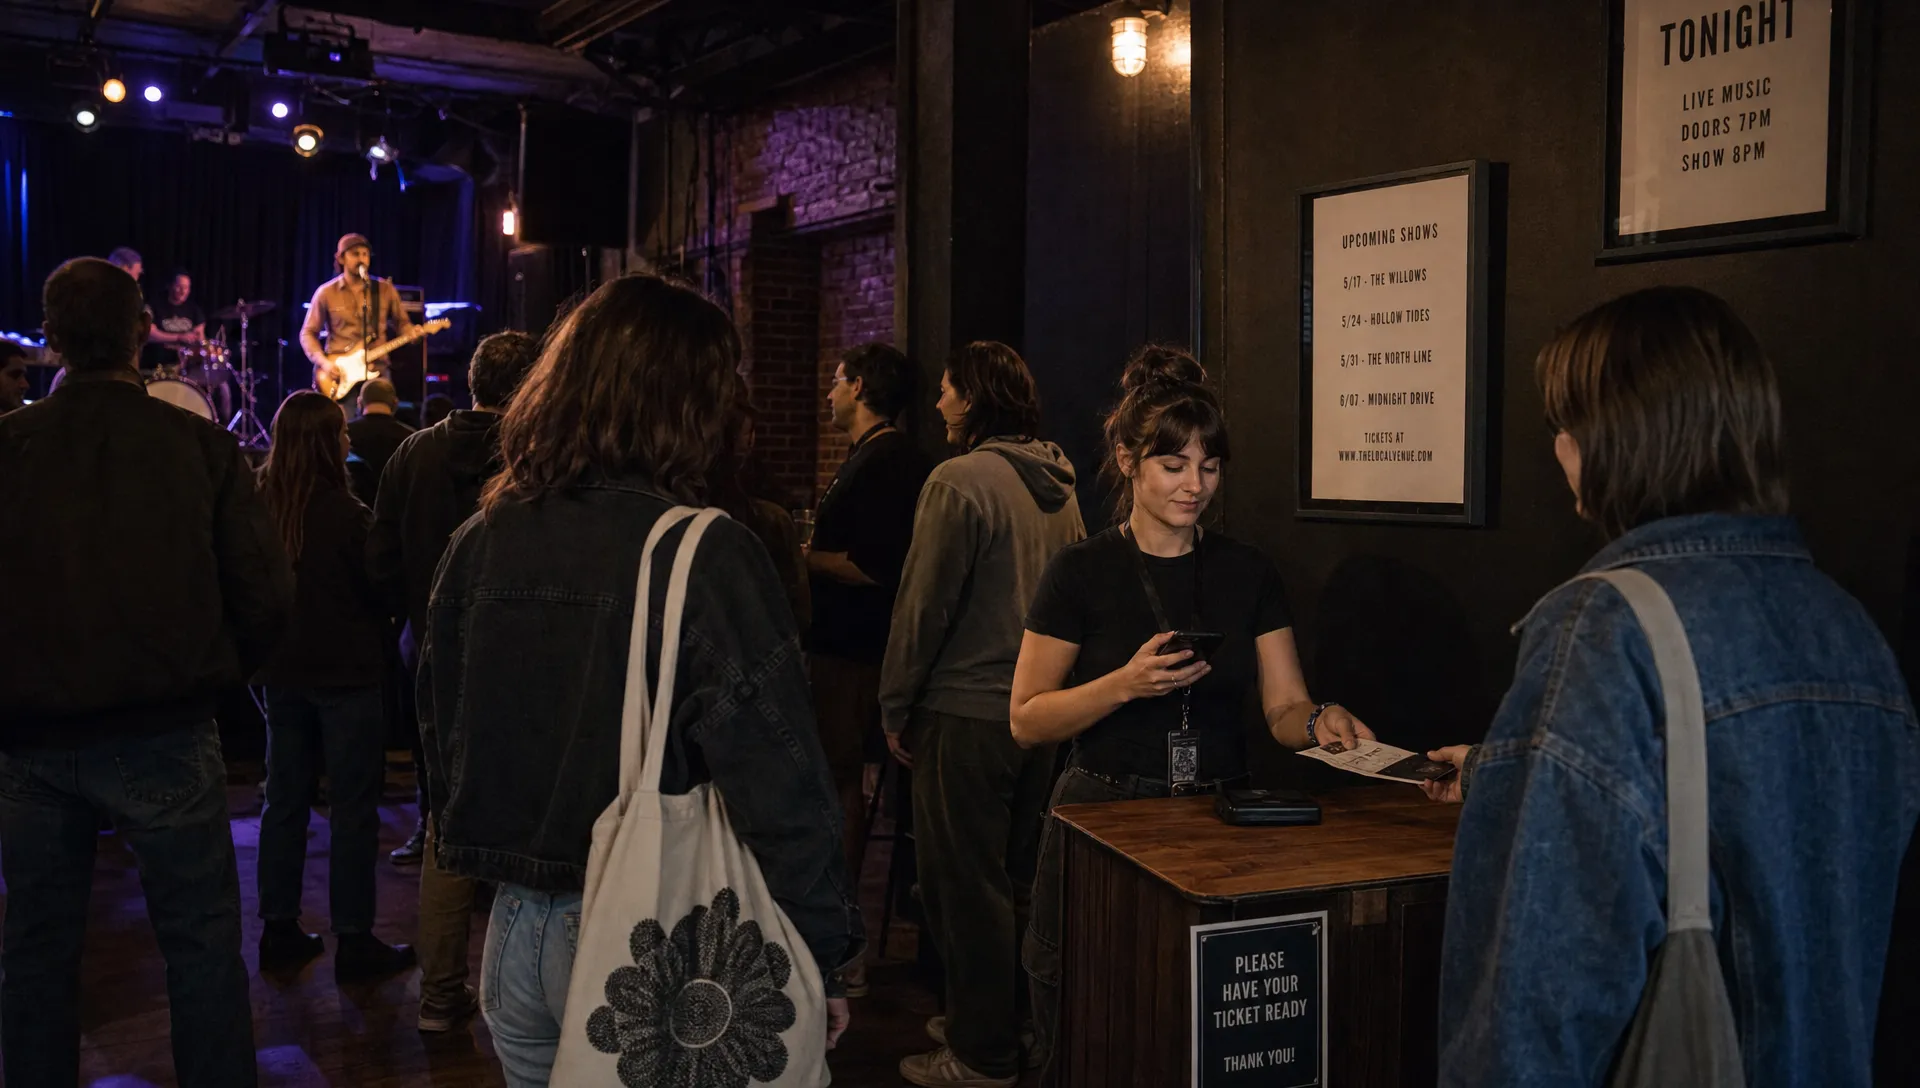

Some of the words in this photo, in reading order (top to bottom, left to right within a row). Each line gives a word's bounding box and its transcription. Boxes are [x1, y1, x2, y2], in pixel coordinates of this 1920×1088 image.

[1660, 0, 1793, 66] TONIGHT
[1683, 88, 1714, 111] LIVE
[1722, 77, 1771, 103] MUSIC
[1682, 116, 1730, 141] DOORS
[1739, 108, 1771, 131] 7PM
[1682, 148, 1724, 172] SHOW
[1733, 141, 1765, 164] 8PM
[1342, 228, 1395, 249] UPCOMING
[1400, 223, 1438, 242] SHOWS
[1343, 275, 1361, 290] 5/17
[1370, 272, 1385, 286] THE
[1389, 268, 1427, 284] WILLOWS
[1341, 314, 1361, 328] 5/24
[1370, 310, 1403, 325] HOLLOW
[1406, 308, 1430, 323] TIDES
[1340, 354, 1359, 368] 5/31
[1368, 352, 1382, 365] THE
[1384, 350, 1411, 365] NORTH
[1413, 349, 1432, 363] LINE
[1340, 393, 1359, 408] 6/07
[1368, 392, 1407, 406] MIDNIGHT
[1410, 391, 1434, 405] DRIVE
[1364, 432, 1393, 443] TICKETS
[1395, 431, 1404, 443] AT
[1338, 450, 1433, 461] WWW.THELOCALVENUE.COM
[1235, 951, 1285, 974] PLEASE
[1222, 980, 1259, 1002] HAVE
[1263, 974, 1299, 996] YOUR
[1213, 1005, 1261, 1029] TICKET
[1265, 998, 1308, 1022] READY
[1224, 1051, 1264, 1073] THANK
[1267, 1046, 1296, 1066] YOU!
